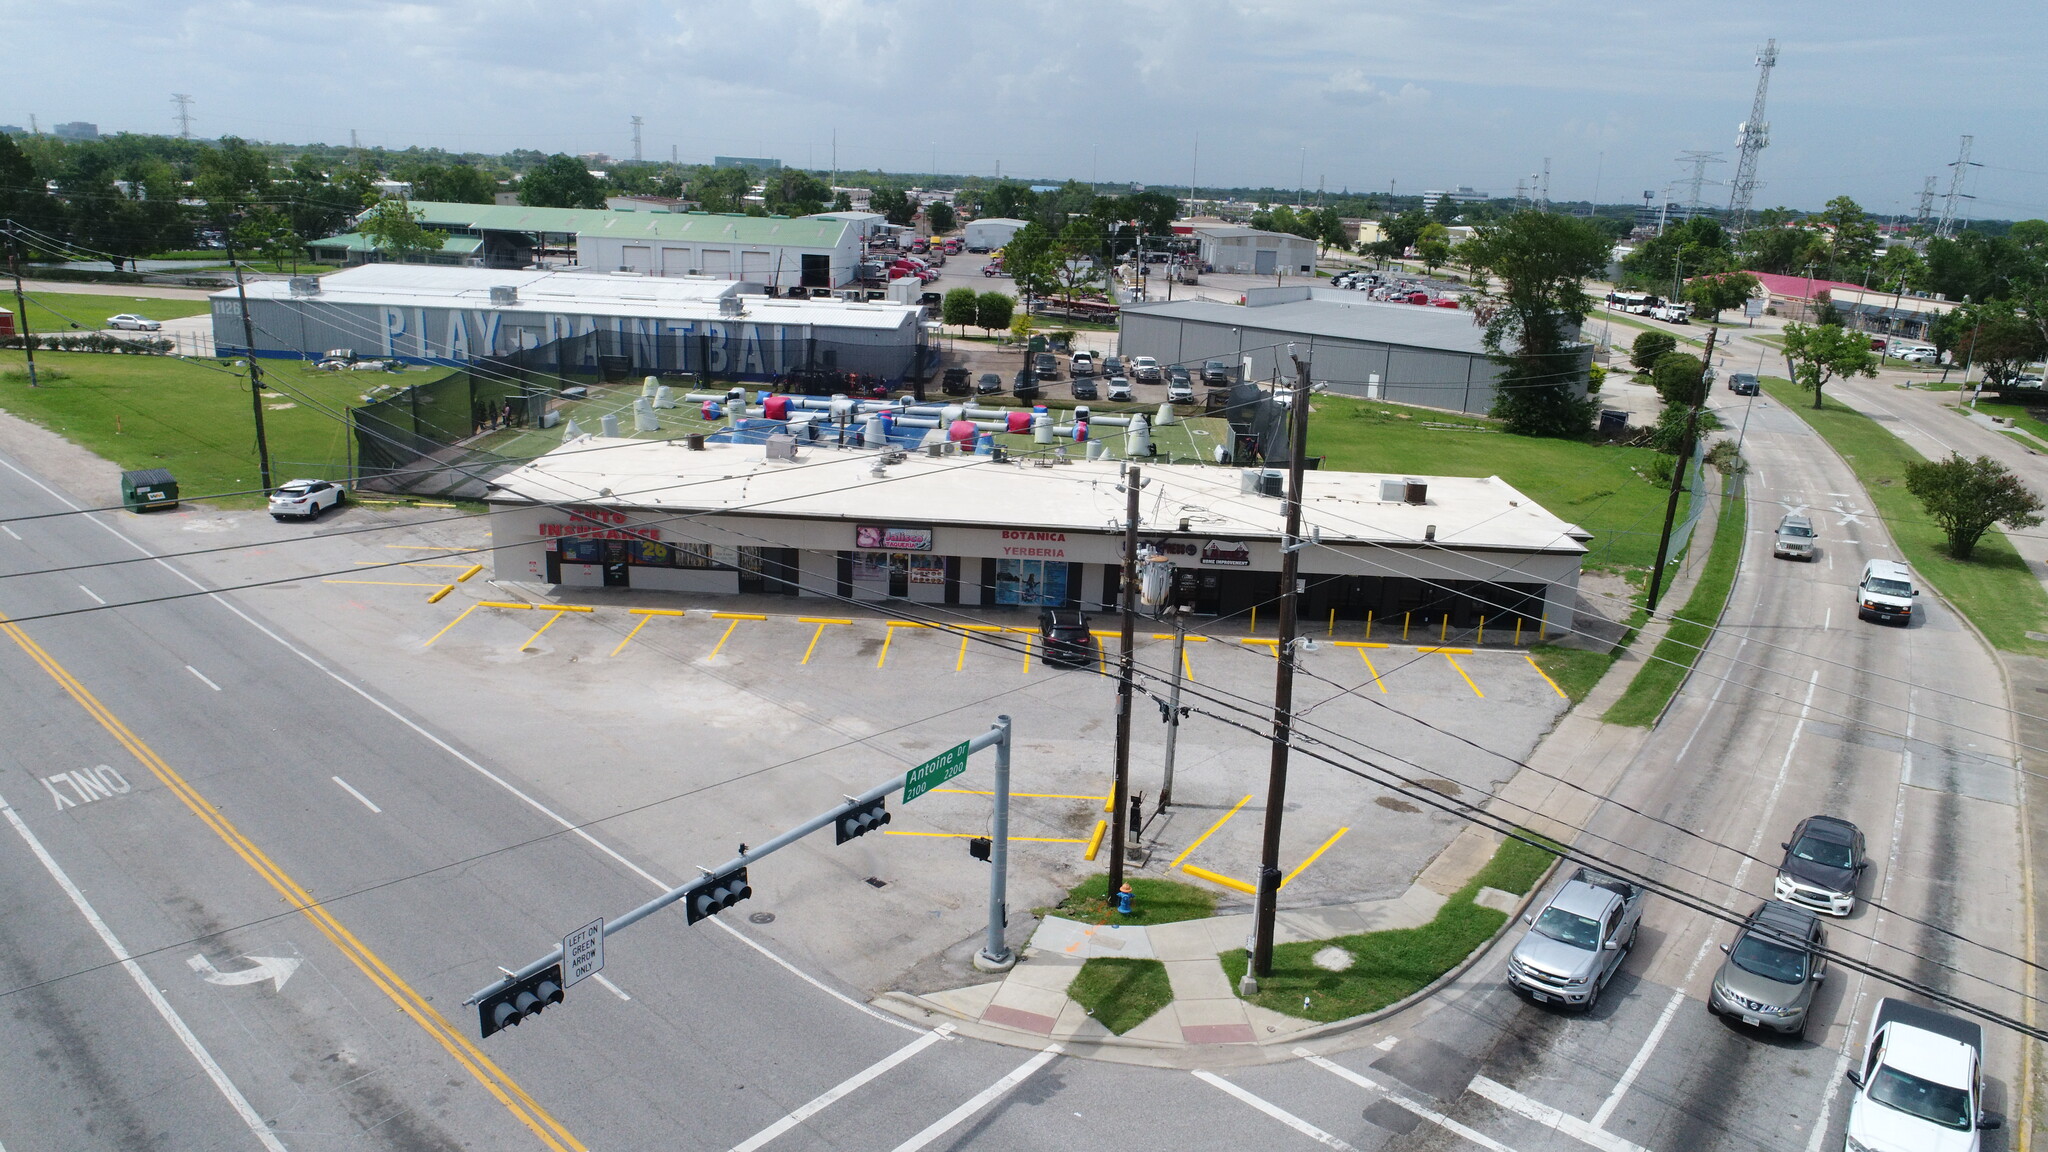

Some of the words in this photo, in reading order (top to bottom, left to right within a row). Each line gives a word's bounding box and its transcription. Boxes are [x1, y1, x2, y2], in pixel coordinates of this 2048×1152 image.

[214, 301, 240, 315] 1126
[380, 306, 502, 360] PLAY
[569, 510, 627, 524] AUTO
[539, 524, 661, 540] INSURANCE
[886, 532, 923, 542] Jalisco
[1002, 530, 1066, 542] BOTANICA
[642, 541, 668, 557] 26
[1003, 546, 1065, 557] YERBERIA
[909, 752, 953, 784] Antoine
[957, 745, 966, 757] Dr
[40, 764, 131, 810] ONLY
[906, 782, 927, 800] 2100
[944, 761, 964, 780] 2200
[569, 931, 585, 947] LEFT
[588, 925, 598, 936] ON
[572, 938, 596, 957] GREEN
[572, 948, 597, 969] ARROW
[575, 962, 593, 978] ONLY
